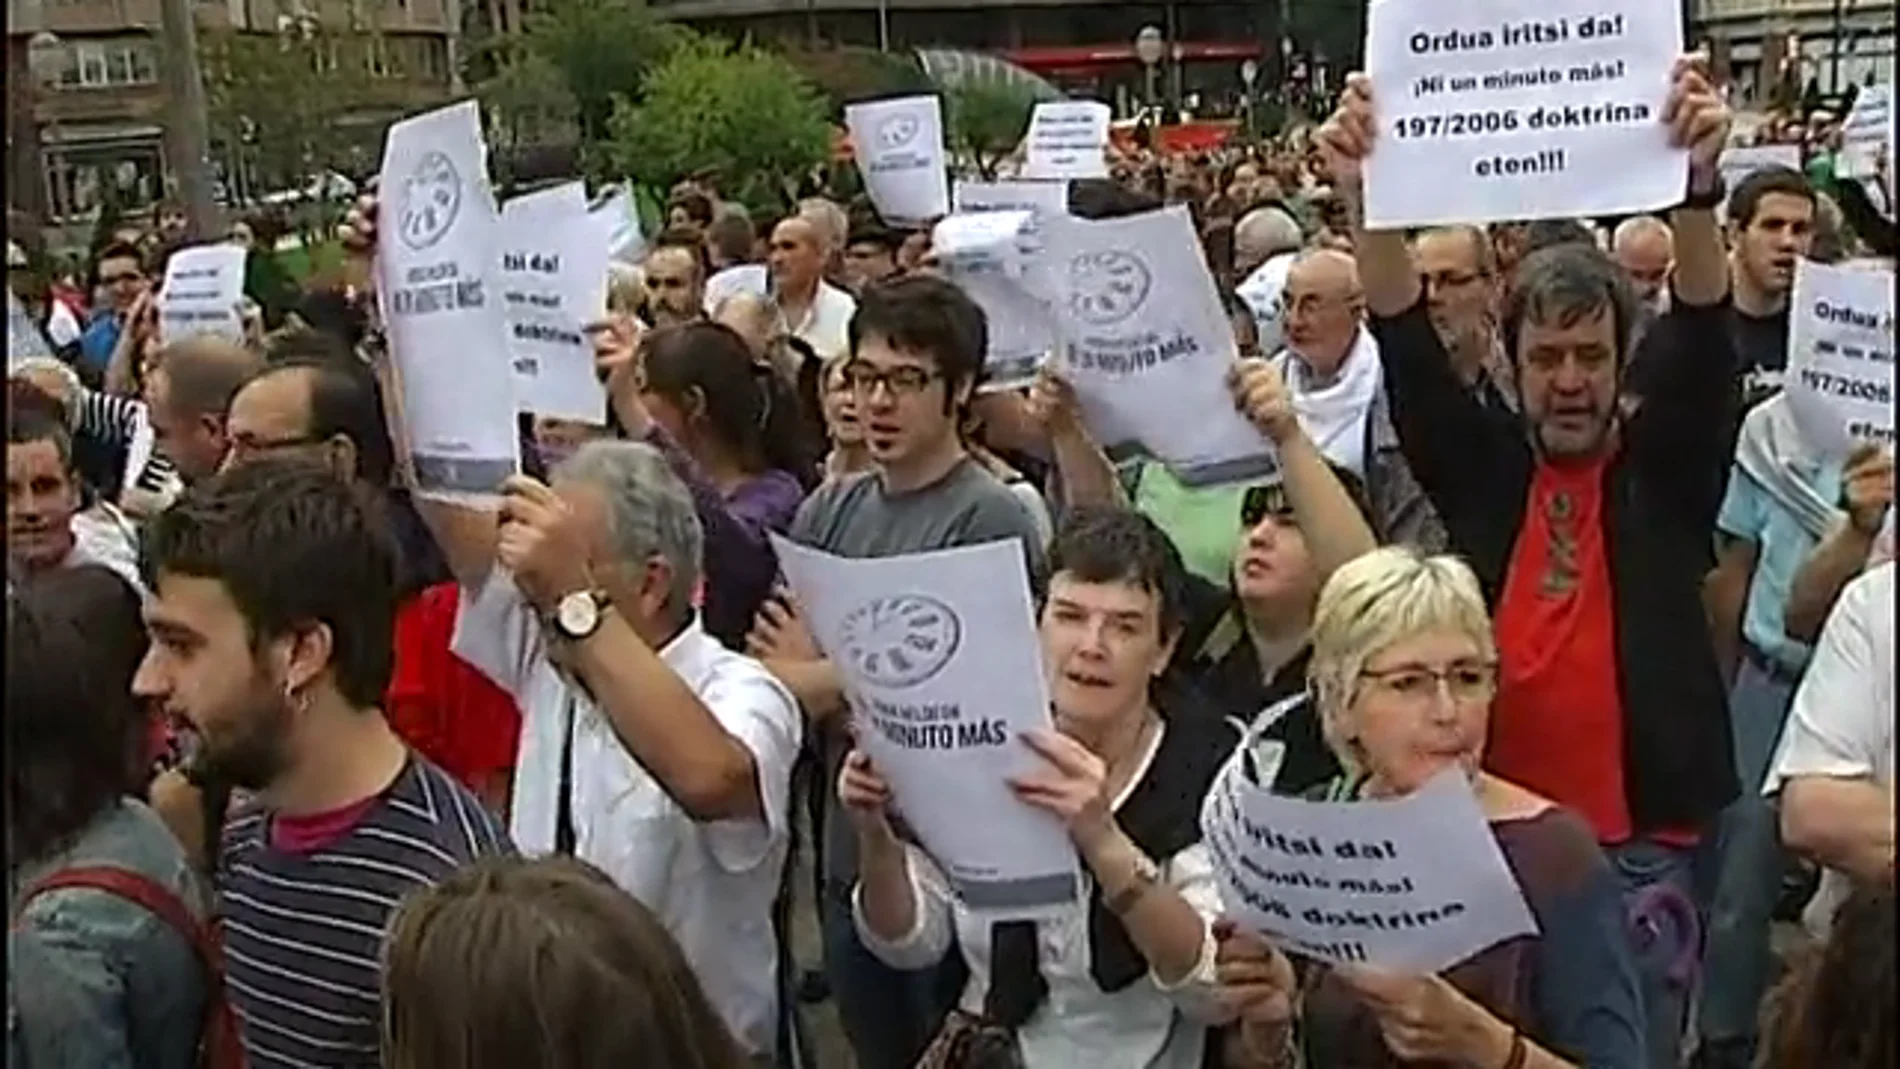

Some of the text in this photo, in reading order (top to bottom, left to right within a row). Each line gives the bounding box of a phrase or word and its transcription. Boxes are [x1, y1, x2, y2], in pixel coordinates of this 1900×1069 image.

[1410, 14, 1623, 54] Ordua iritsi da!
[1450, 77, 1477, 92] un
[1482, 69, 1562, 89] minuto
[1568, 60, 1625, 82] más!
[1394, 102, 1651, 138] 197/2006 doktrina
[1475, 149, 1565, 176] eten!!!
[1814, 300, 1878, 329] Ordua
[958, 713, 1008, 748] MÁS
[1335, 838, 1399, 860] da!
[1302, 901, 1466, 932] doktrina
